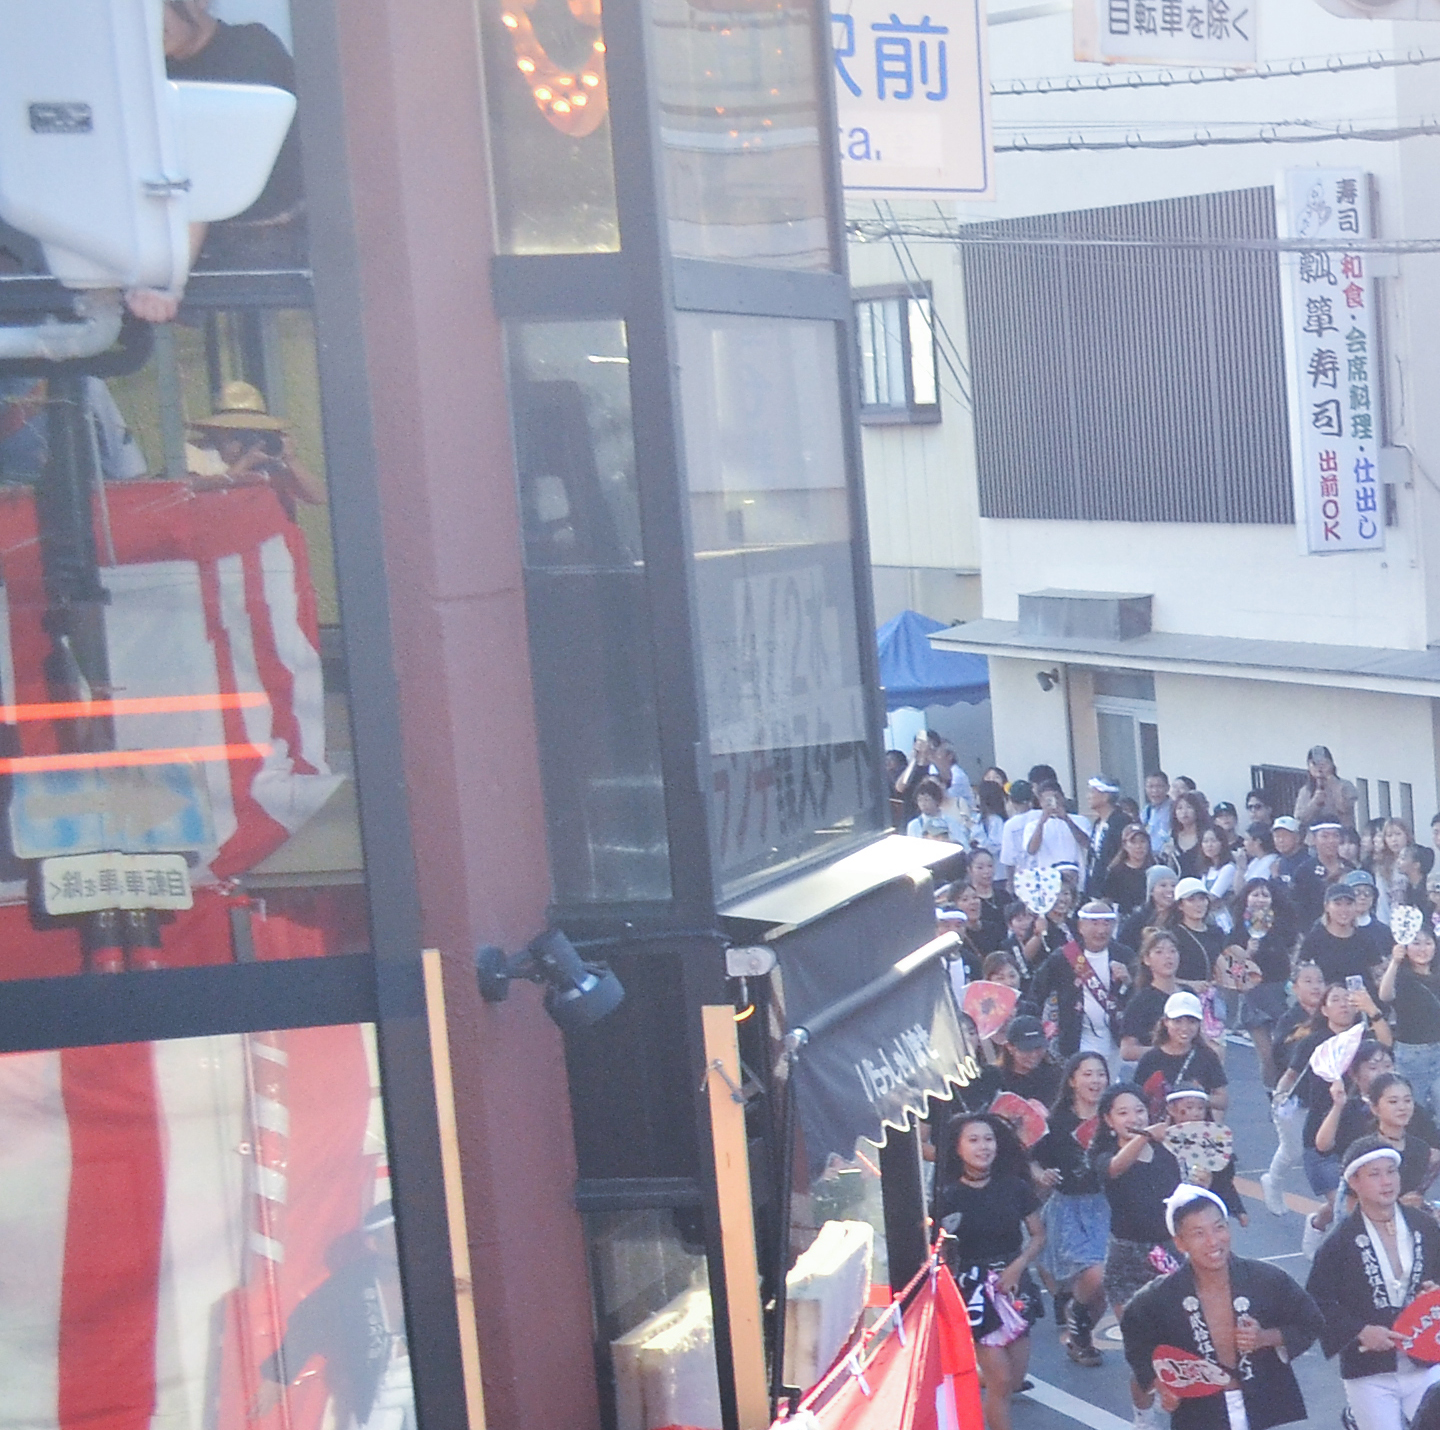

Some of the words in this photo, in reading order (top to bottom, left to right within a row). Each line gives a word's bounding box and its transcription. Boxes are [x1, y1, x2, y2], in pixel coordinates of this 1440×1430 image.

[1108, 0, 1249, 41] 自転車を除く
[1318, 449, 1342, 542] 出前OK
